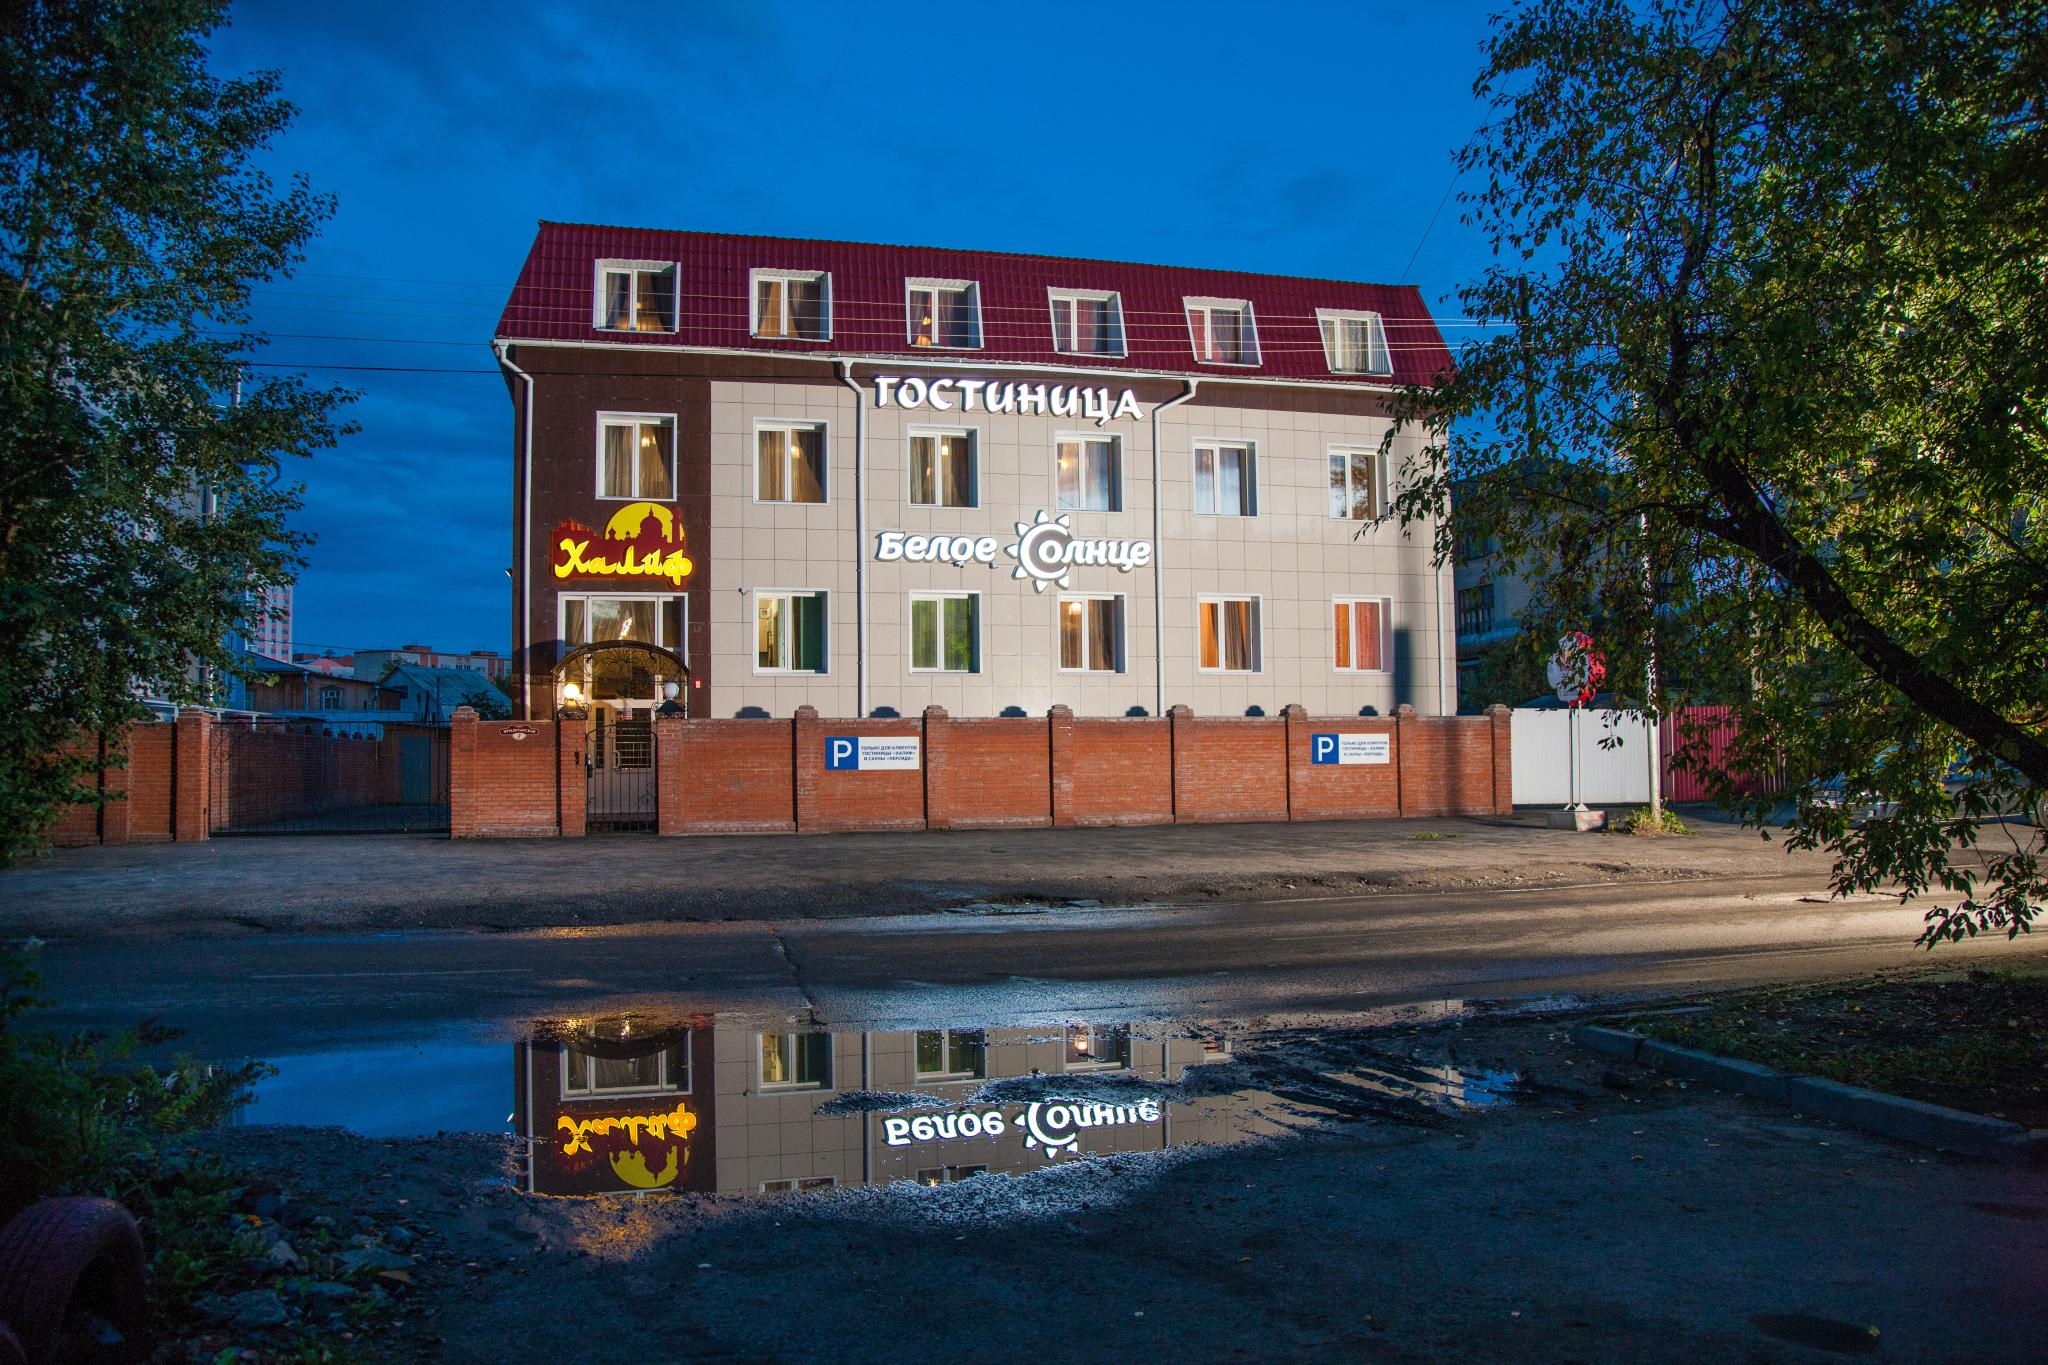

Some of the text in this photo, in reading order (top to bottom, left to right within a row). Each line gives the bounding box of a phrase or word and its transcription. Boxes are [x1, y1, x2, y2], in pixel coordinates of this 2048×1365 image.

[874, 375, 1145, 427] ГОСТИНИЦА
[554, 537, 693, 586] Халиф
[875, 522, 1151, 582] Белое Солнце
[833, 740, 853, 767] P
[1317, 736, 1334, 762] P
